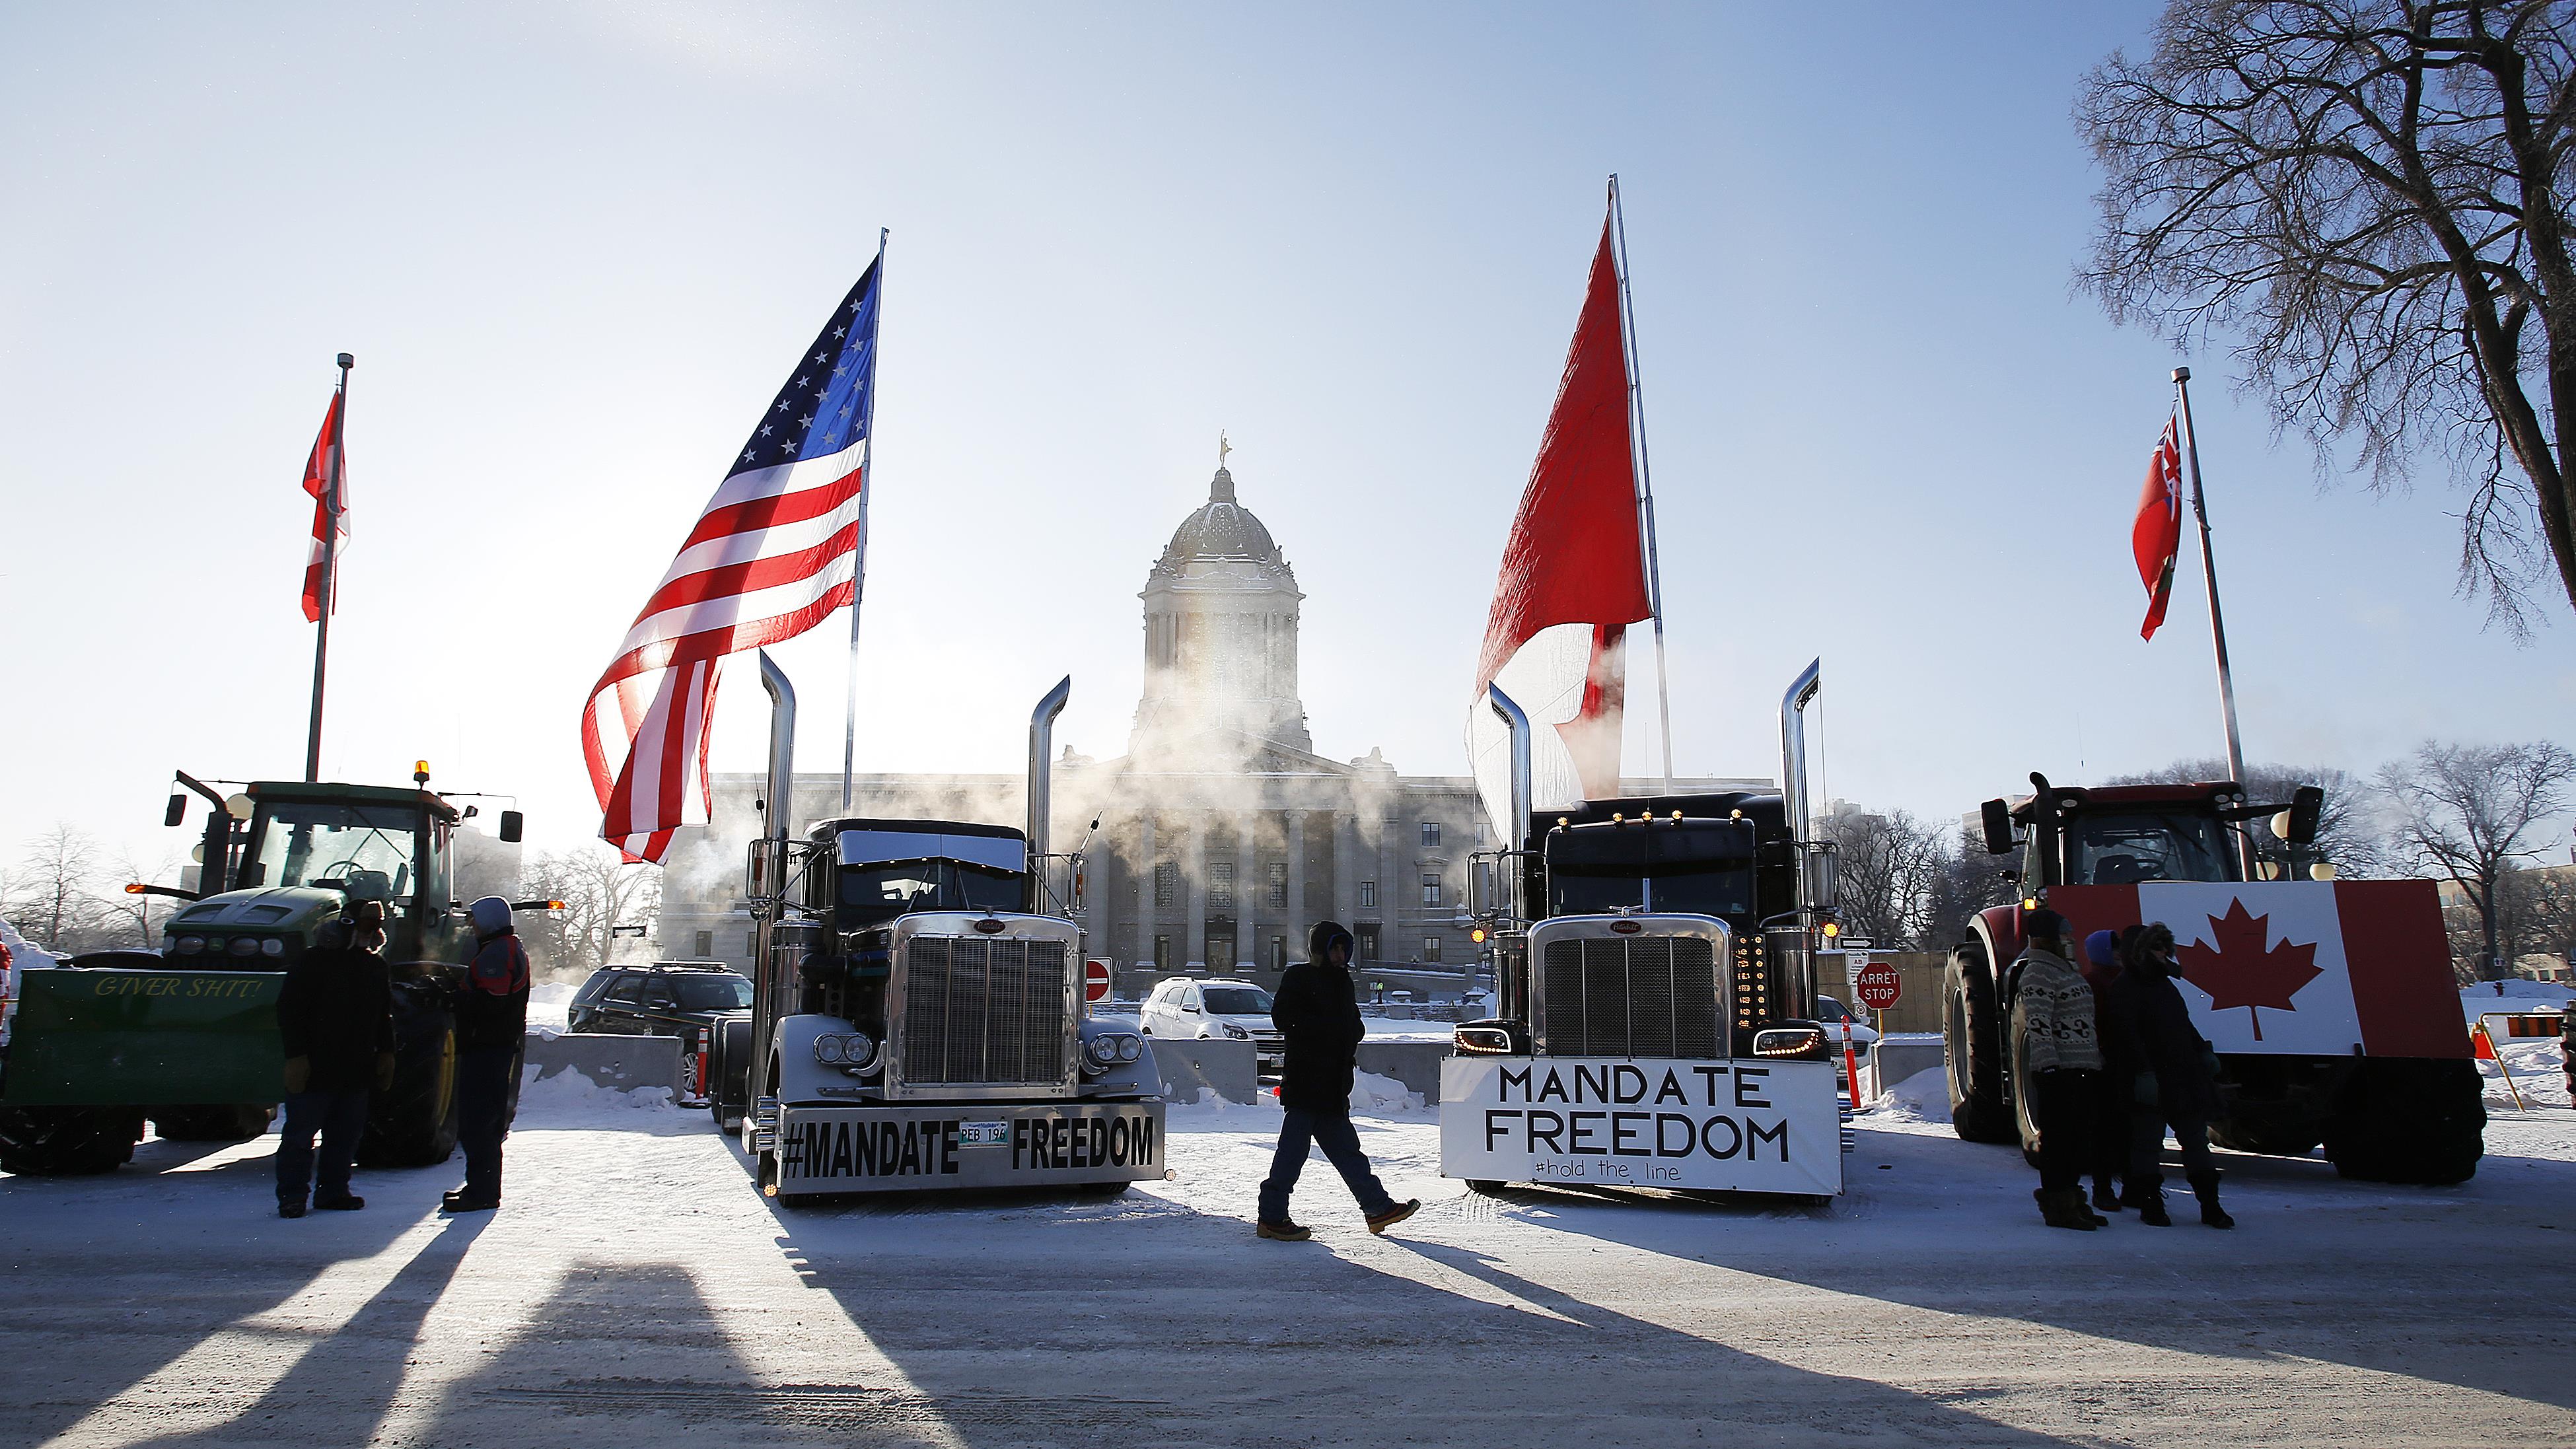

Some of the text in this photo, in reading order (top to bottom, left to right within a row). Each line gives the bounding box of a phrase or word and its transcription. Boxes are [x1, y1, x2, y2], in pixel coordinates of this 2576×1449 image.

[94, 977, 264, 998] GIVER SHIT!
[1860, 971, 1898, 985] ARRÊT
[1865, 988, 1894, 1000] STOP
[1499, 1064, 1772, 1109] MANDATE
[961, 1128, 1006, 1141] PEB 196
[1484, 1108, 1789, 1162] FREEDOM
[781, 1116, 1153, 1179] #MANDATE FREEDOM
[1534, 1158, 1682, 1182] #hold the line
